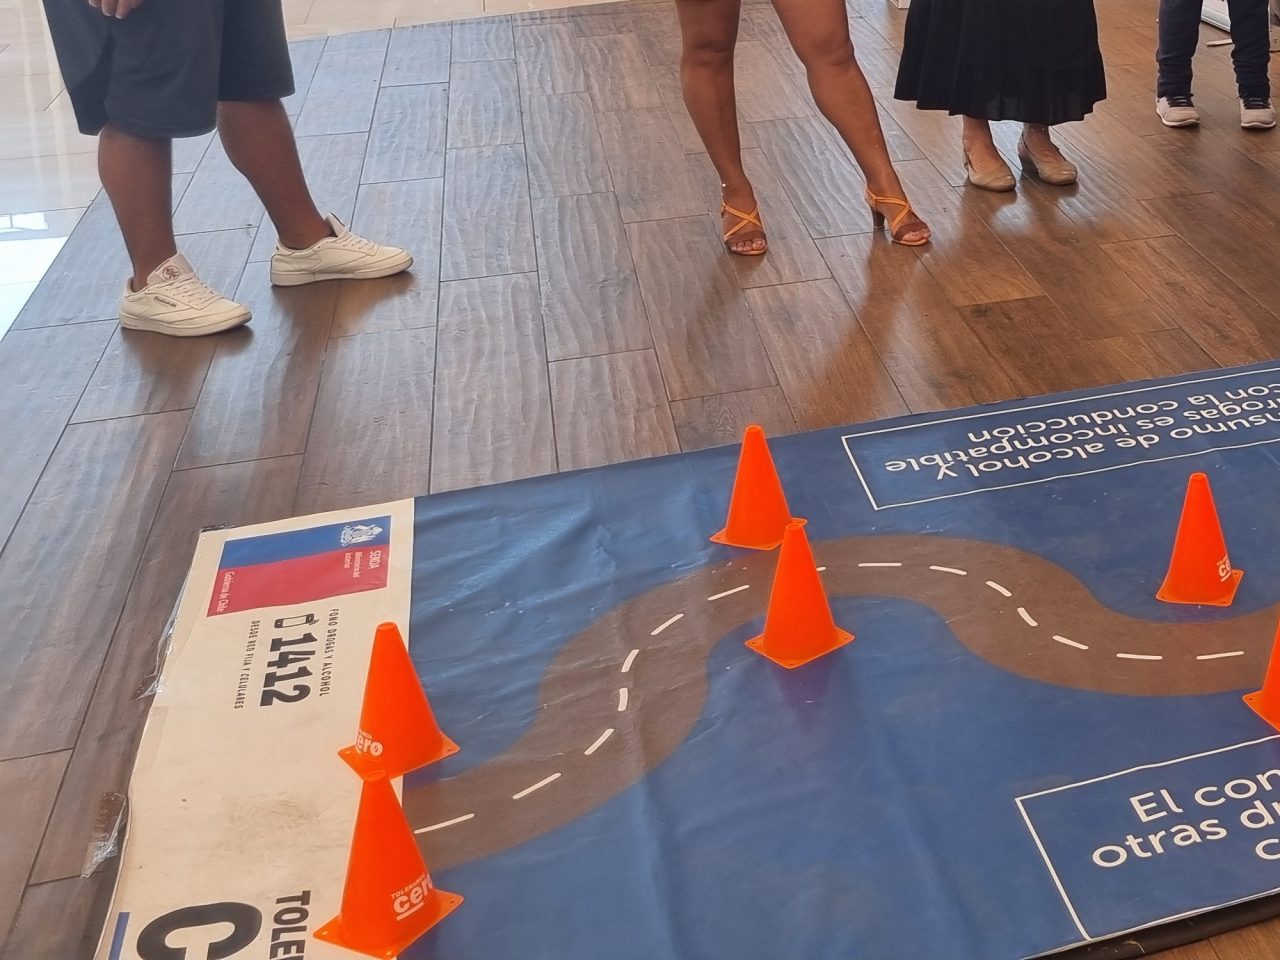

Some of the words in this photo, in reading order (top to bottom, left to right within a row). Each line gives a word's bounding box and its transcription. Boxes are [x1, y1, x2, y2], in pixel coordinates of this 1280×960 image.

[1187, 392, 1220, 406] la
[967, 399, 1179, 443] conducción
[1136, 416, 1175, 430] es
[885, 423, 1130, 472] incompatible
[1115, 433, 1160, 450] de
[936, 460, 960, 481] y
[965, 442, 1106, 477] alcohol
[369, 550, 382, 569] SENDA
[248, 620, 261, 639] DESDE
[328, 608, 340, 627] FONO
[245, 640, 257, 651] RED
[324, 629, 337, 654] DROGAS
[243, 653, 254, 665] FIJA
[259, 632, 318, 707] 1412
[234, 673, 249, 709] CELULARES
[319, 662, 333, 697] ALCOHOL
[1129, 789, 1185, 823] El
[1092, 819, 1229, 868] otras
[269, 889, 312, 960] TOLE
